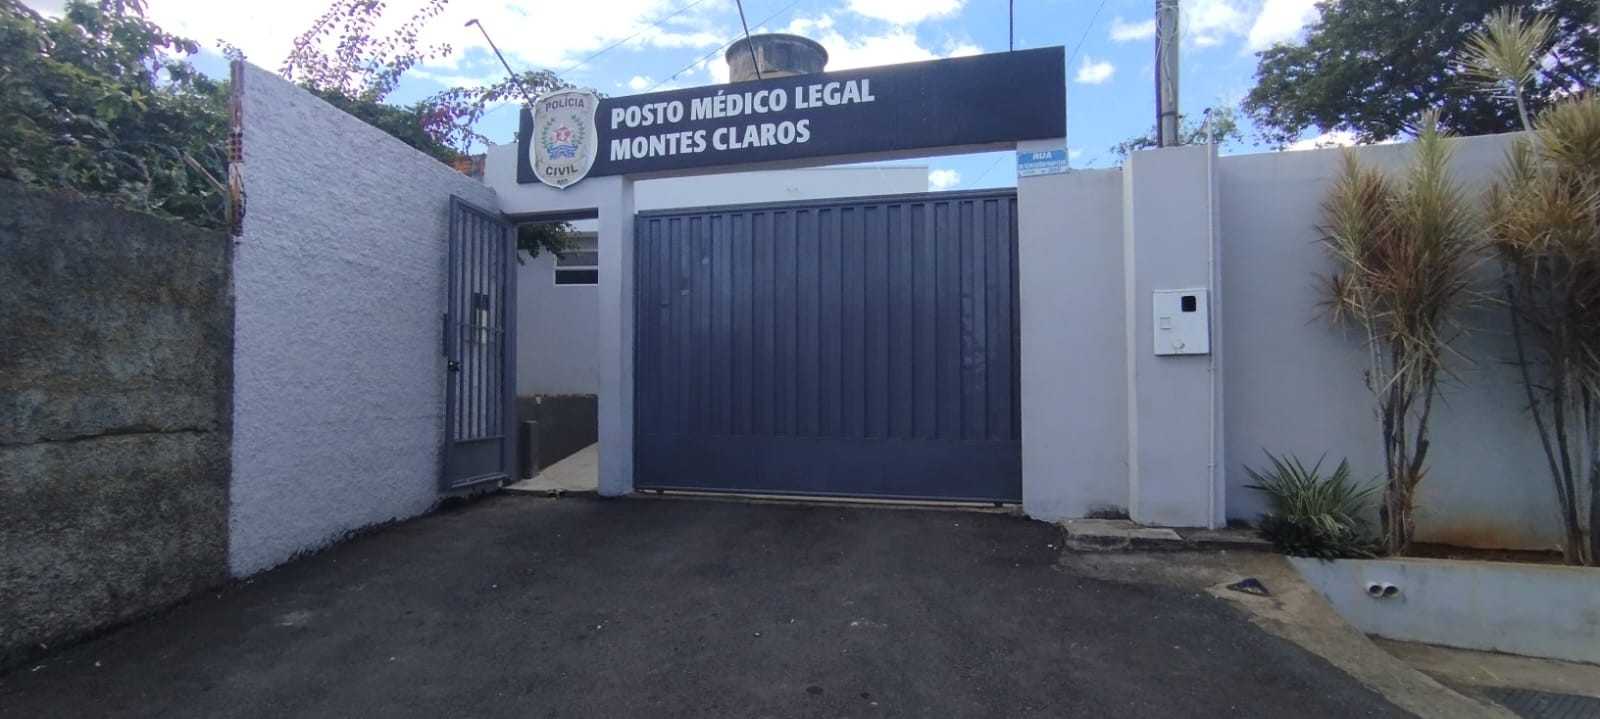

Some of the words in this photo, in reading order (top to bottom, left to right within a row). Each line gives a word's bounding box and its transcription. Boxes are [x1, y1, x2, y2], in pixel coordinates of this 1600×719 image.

[545, 96, 585, 112] POLÍCIA
[611, 100, 684, 129] POSTO
[691, 88, 787, 121] MÉDICO
[795, 79, 875, 109] LEGAL
[610, 130, 706, 161] MONTES
[712, 119, 811, 151] CLAROS
[1032, 151, 1053, 161] RUA
[545, 164, 578, 176] CIVIL
